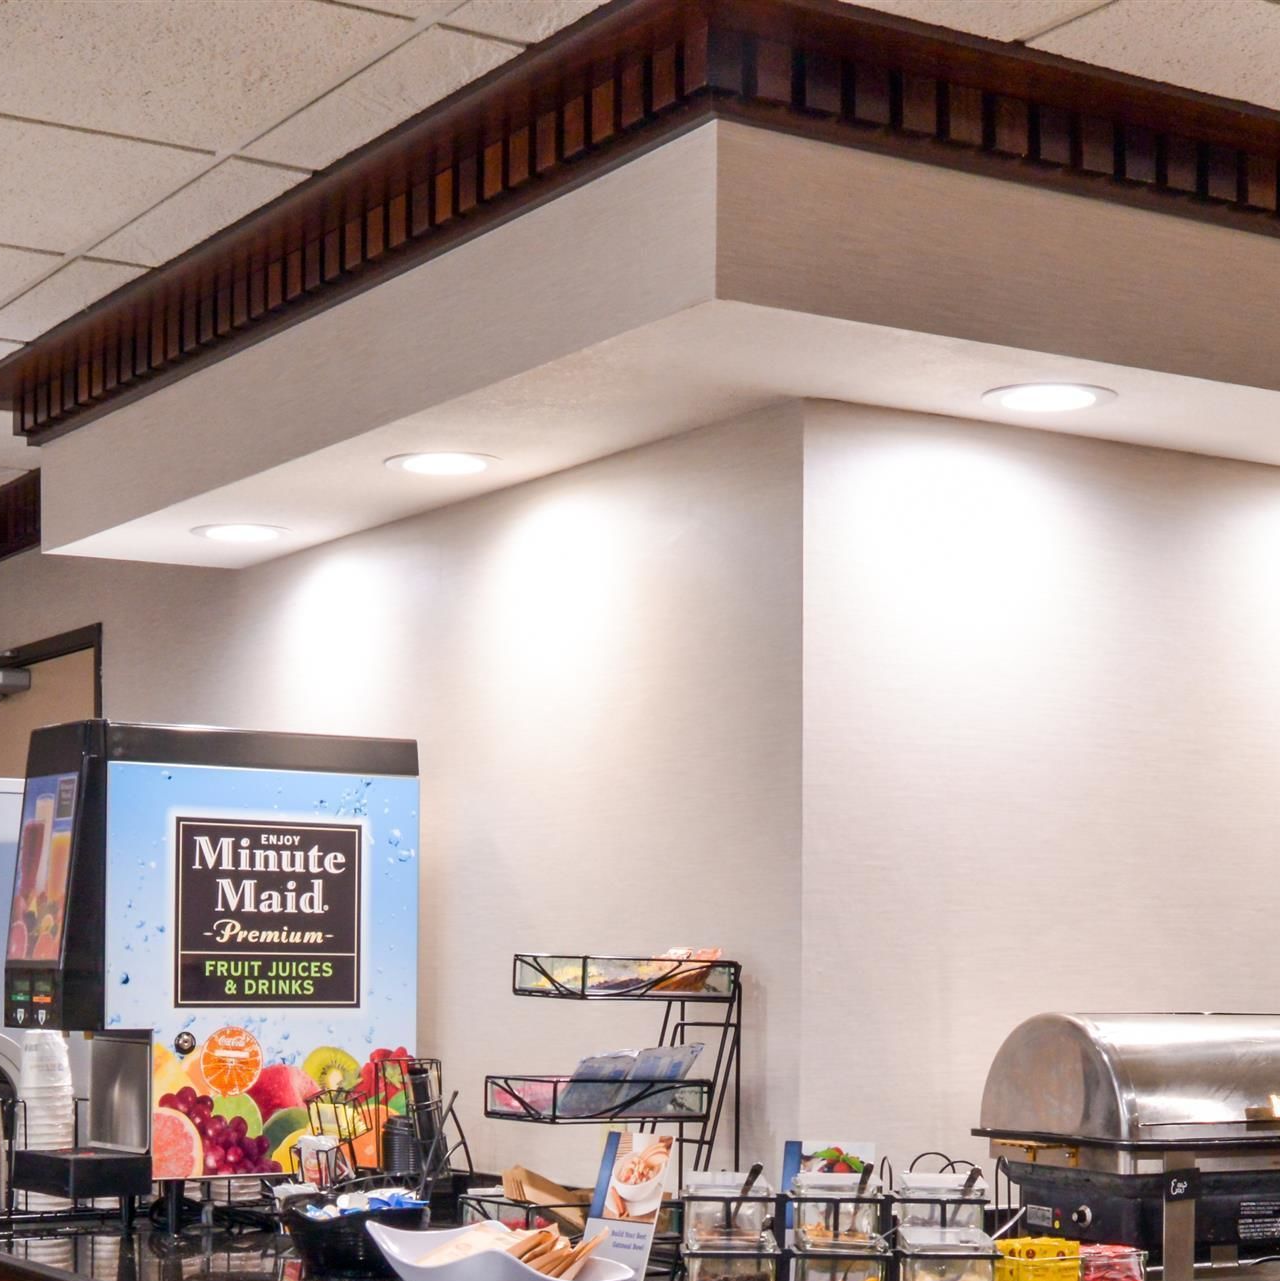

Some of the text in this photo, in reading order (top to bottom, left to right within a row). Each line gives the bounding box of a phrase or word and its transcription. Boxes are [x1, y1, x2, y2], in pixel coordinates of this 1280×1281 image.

[261, 834, 301, 846] ENJOY
[192, 835, 346, 874] Minute
[214, 878, 326, 914] Maid
[205, 960, 333, 978] FRUIT JUICES
[224, 979, 314, 996] & DRINKS
